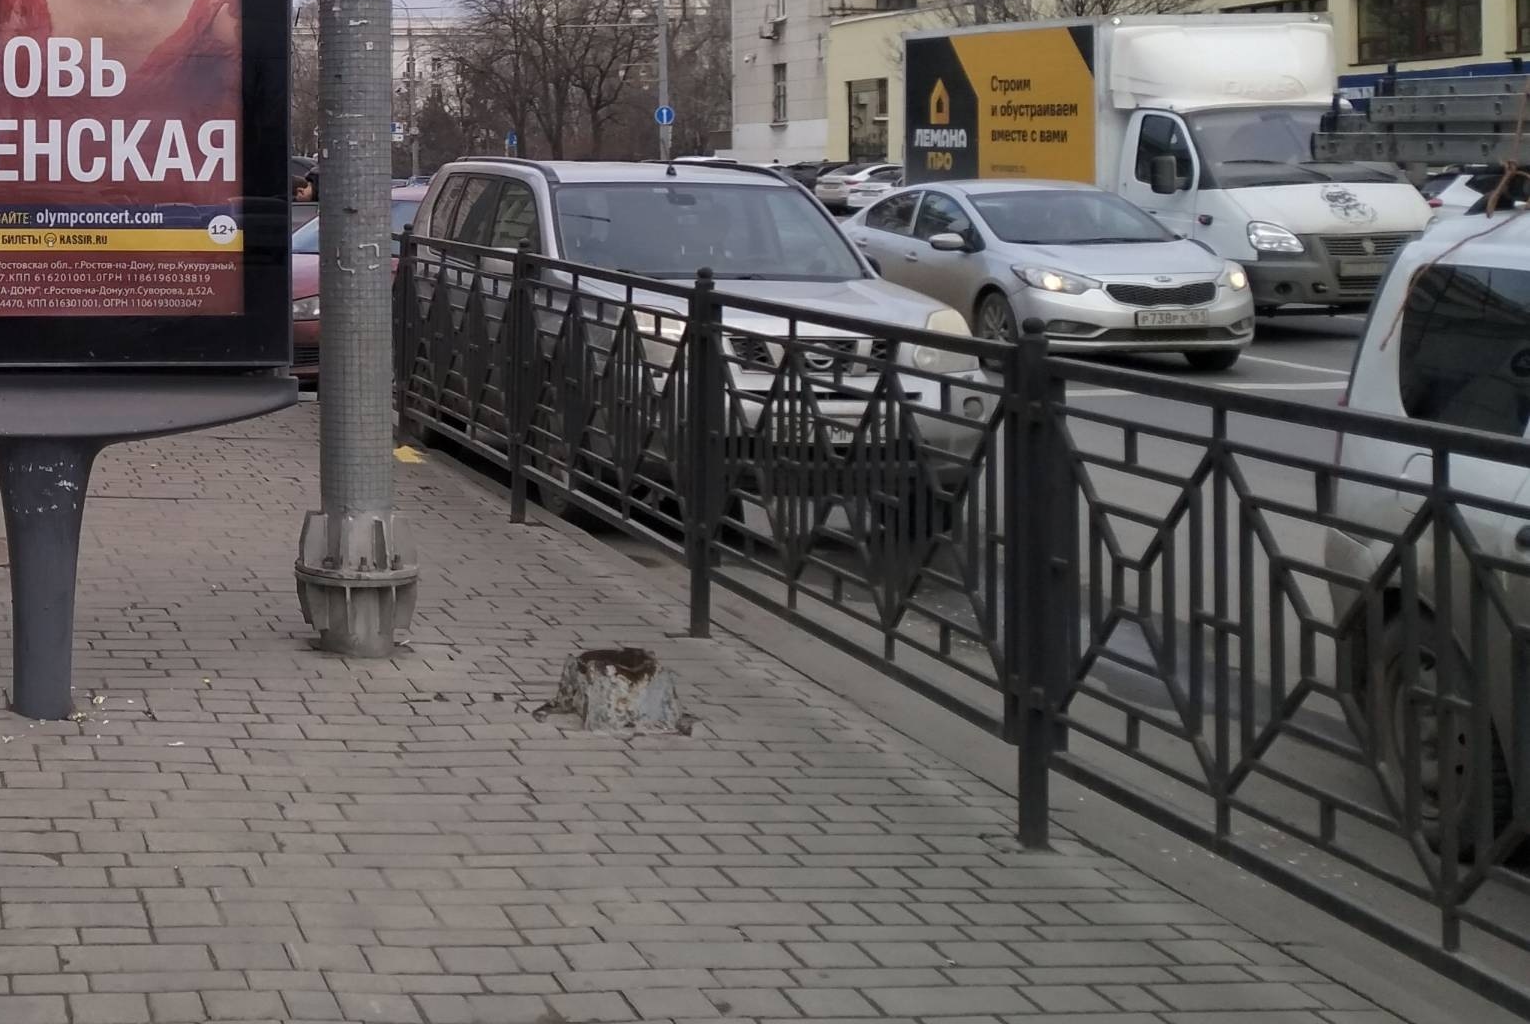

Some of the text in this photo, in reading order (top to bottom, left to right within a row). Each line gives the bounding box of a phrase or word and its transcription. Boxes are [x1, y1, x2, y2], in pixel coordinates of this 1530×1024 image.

[990, 75, 1031, 95] Строим
[991, 100, 1078, 121] и обустраиваем
[914, 129, 968, 148] ЛЕМАНА
[991, 130, 1068, 143] вместе с вами
[927, 151, 953, 170] ПРО
[36, 209, 164, 227] olympconcert.com
[211, 225, 235, 235] 12+
[2, 235, 42, 245] БИЛЕТЫ
[27, 299, 47, 308] КПП
[103, 299, 128, 307] ОГРН
